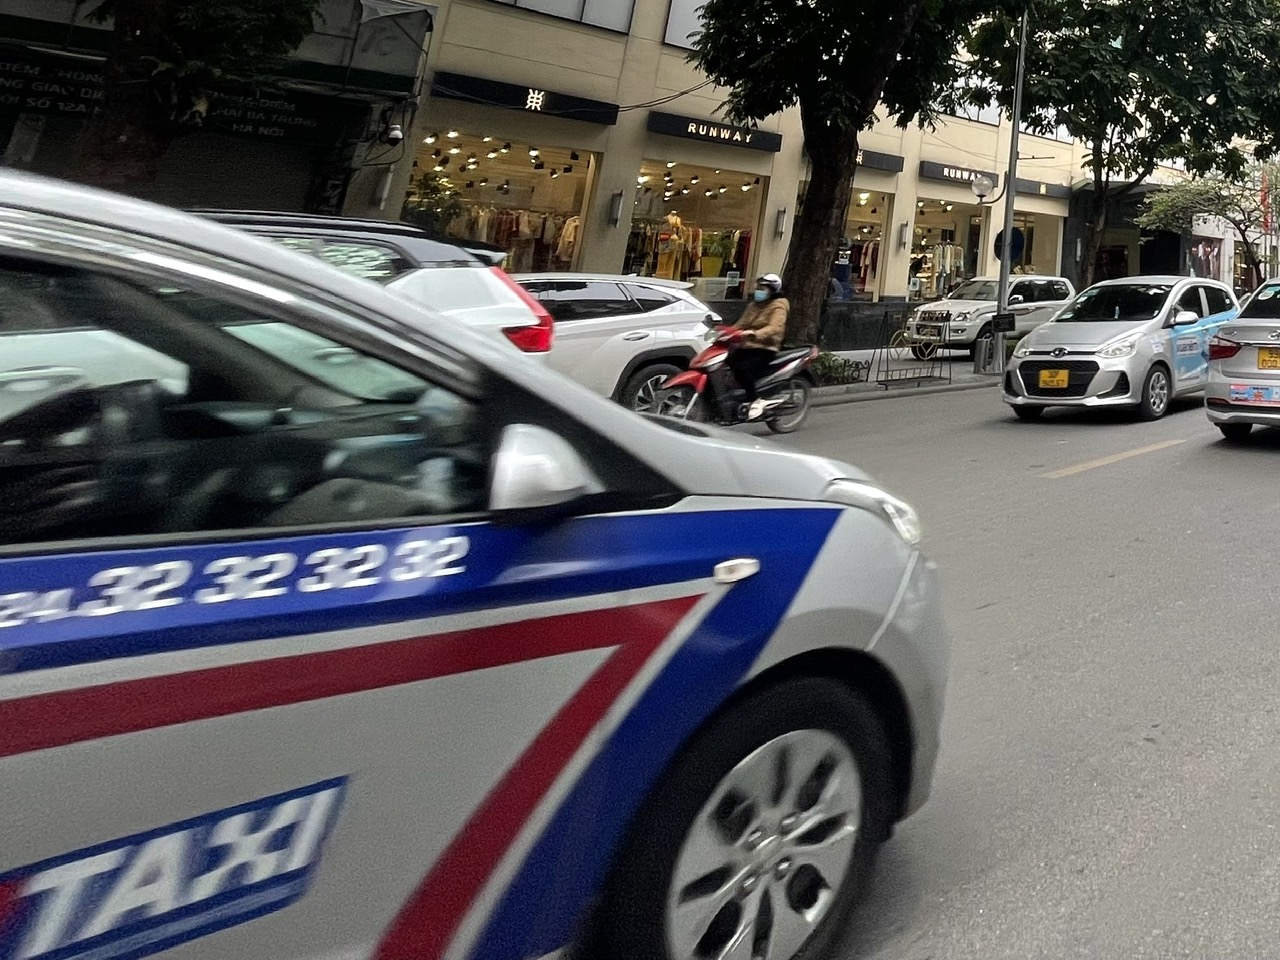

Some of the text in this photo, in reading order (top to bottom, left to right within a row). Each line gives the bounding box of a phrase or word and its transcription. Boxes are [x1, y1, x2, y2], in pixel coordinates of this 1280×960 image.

[687, 122, 752, 143] RUNWAY
[194, 552, 298, 604] 32
[298, 544, 389, 592] 32
[390, 536, 471, 581] 32
[15, 788, 341, 960] TAXI
